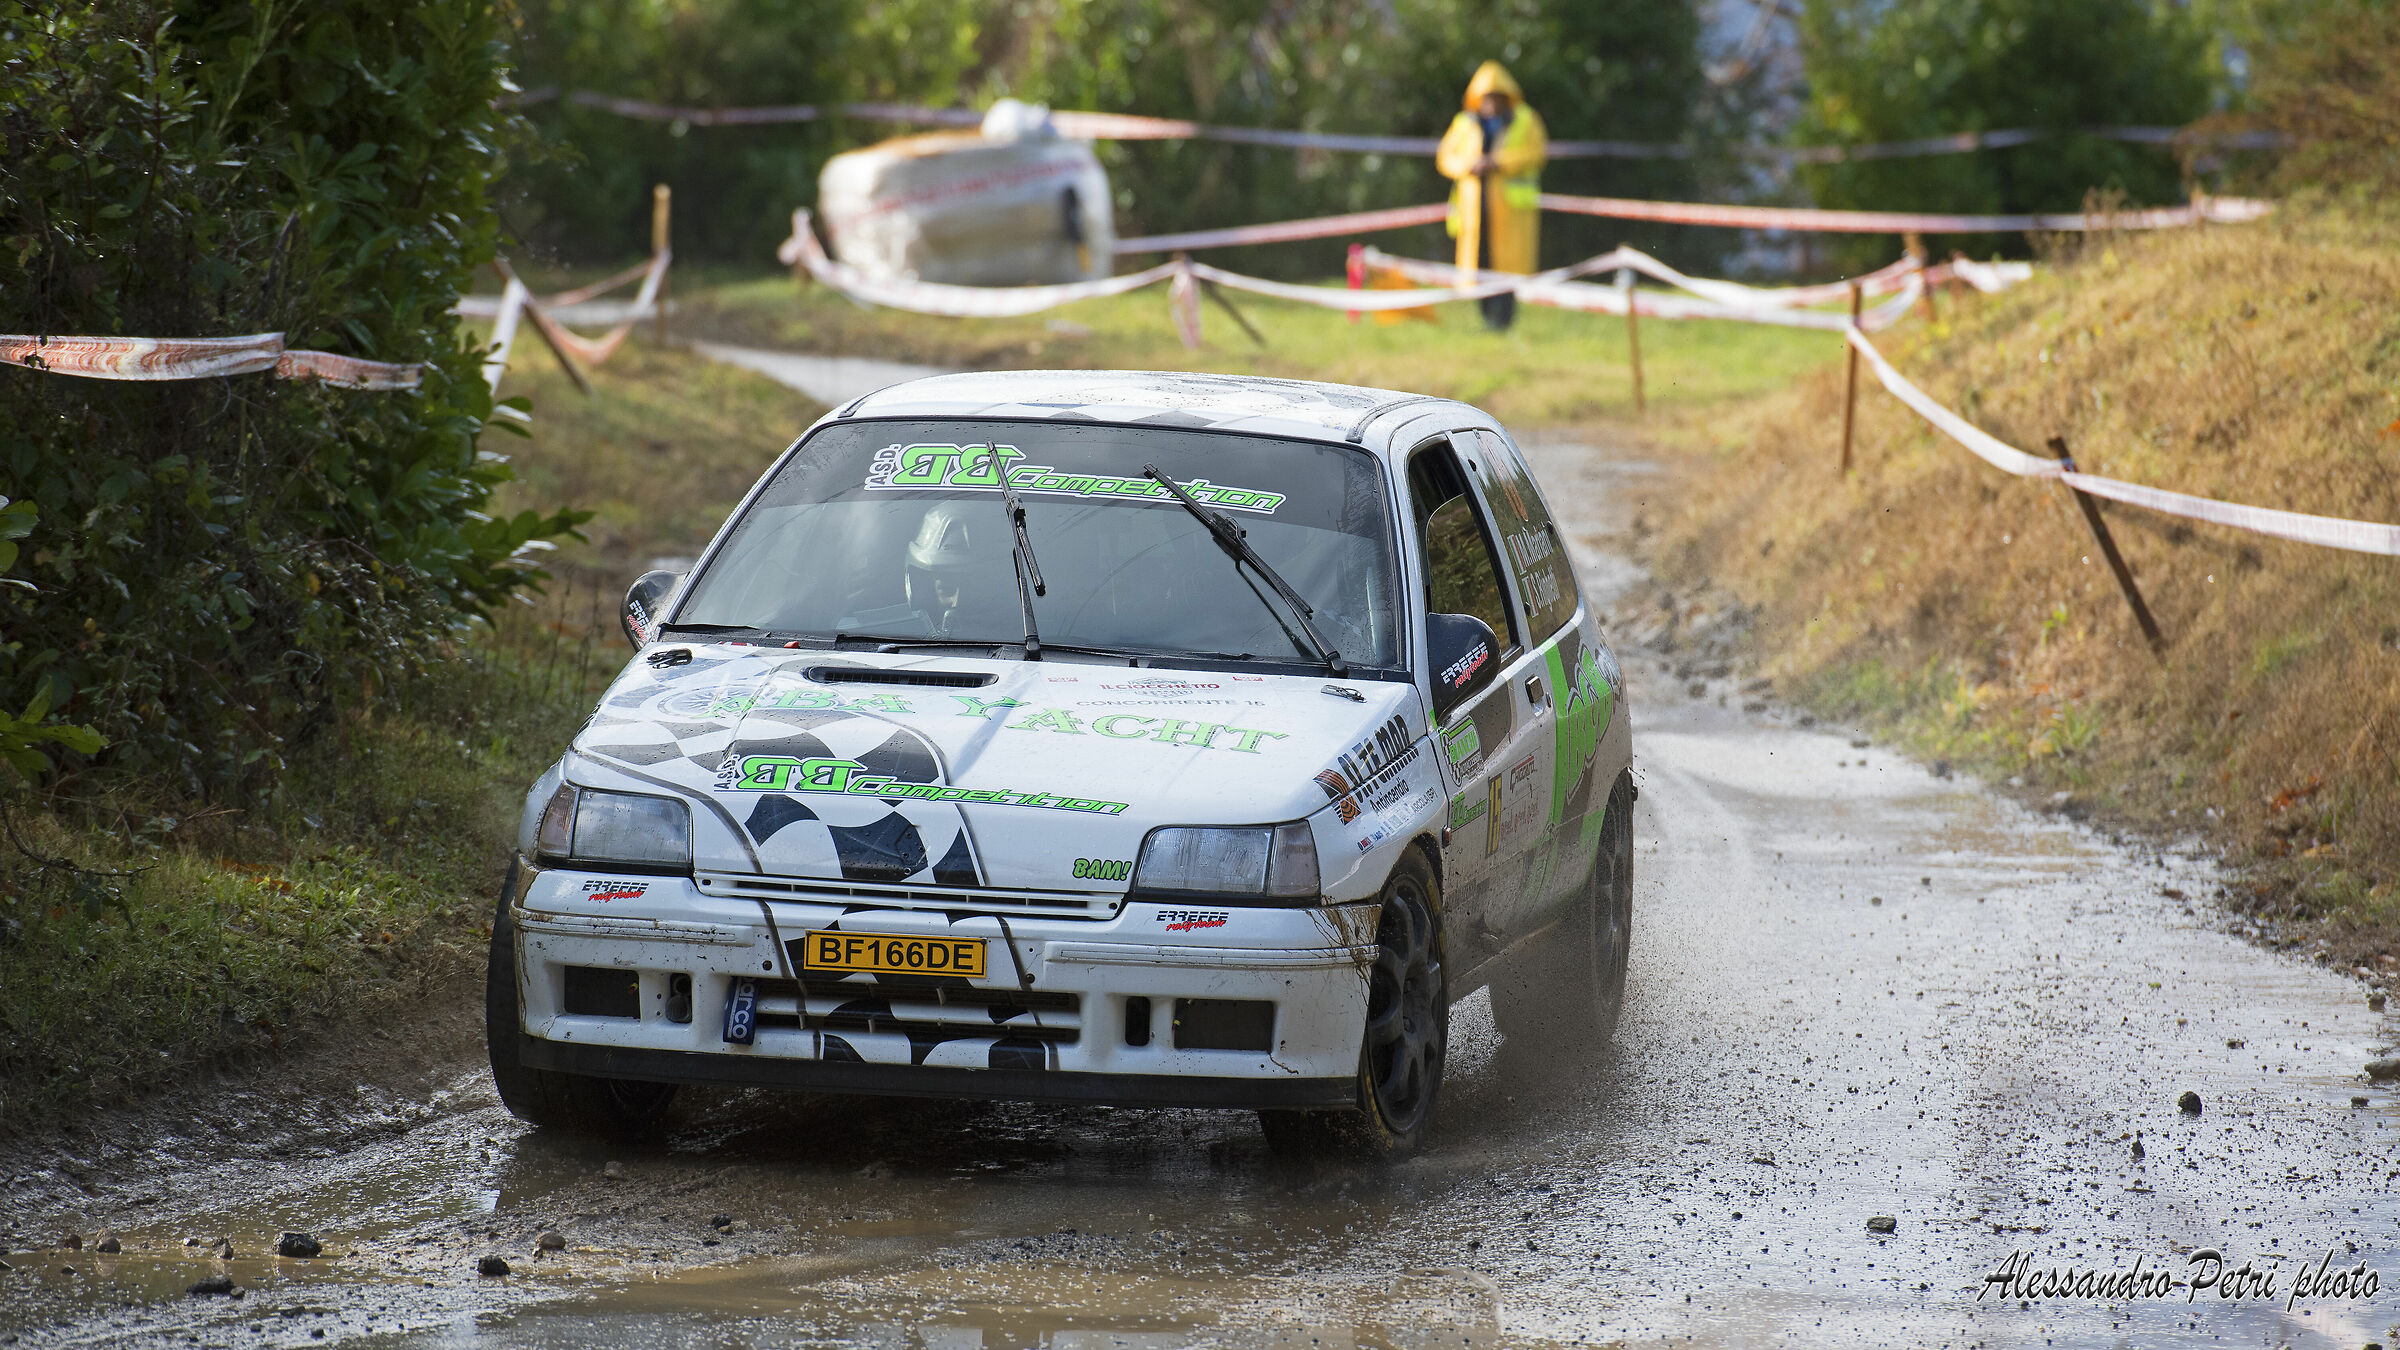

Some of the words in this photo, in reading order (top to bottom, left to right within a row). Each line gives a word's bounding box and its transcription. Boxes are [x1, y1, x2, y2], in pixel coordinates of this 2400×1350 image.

[1441, 641, 1487, 684] ERREFFE
[1076, 699, 1237, 707] CONCORRENTE
[949, 695, 1288, 754] YACHT
[847, 776, 1129, 815] Competition
[1370, 777, 1410, 814] Antincendio
[582, 880, 649, 893] ERREFFE
[1073, 858, 1132, 882] BAM!
[1156, 911, 1229, 923] ERREFFE
[819, 937, 975, 973] BF166DE
